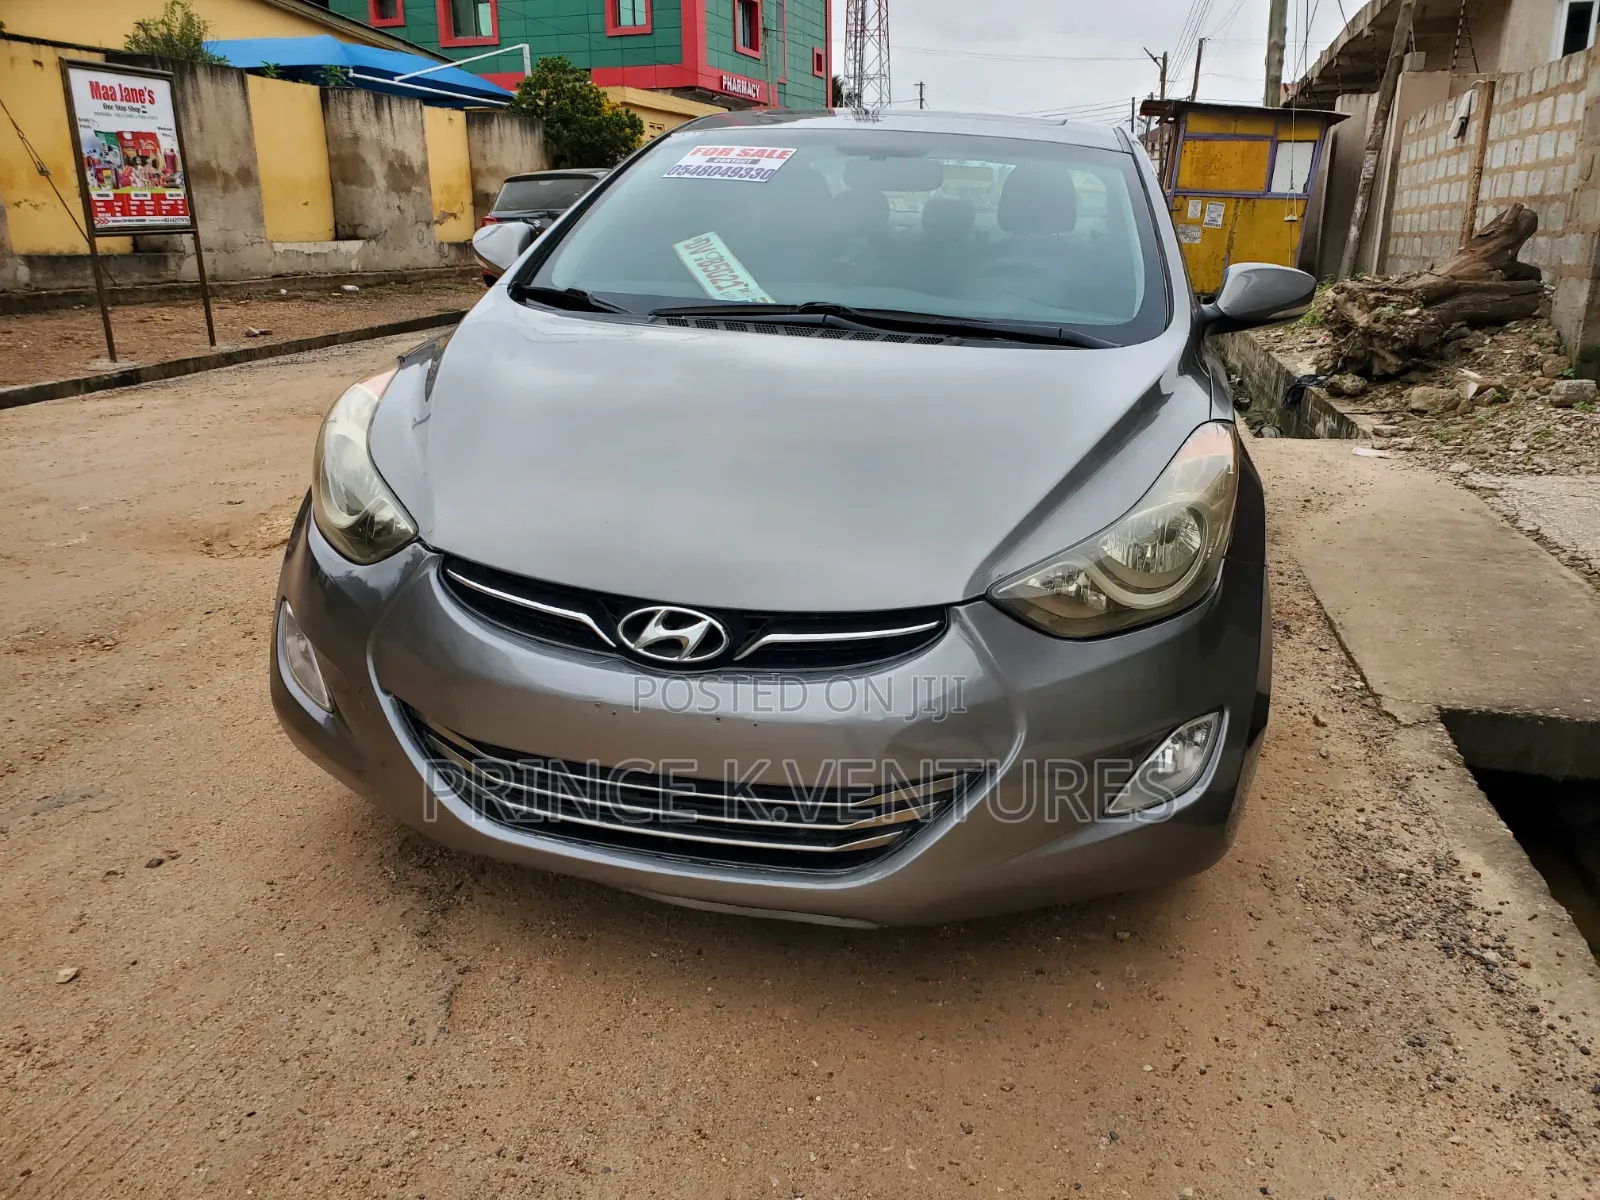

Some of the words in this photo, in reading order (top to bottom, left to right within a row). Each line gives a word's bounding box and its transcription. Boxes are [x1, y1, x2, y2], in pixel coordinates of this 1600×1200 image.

[89, 80, 118, 102] Maa
[118, 84, 156, 106] Jane's
[722, 75, 760, 99] PHARMACY
[103, 102, 114, 111] One
[115, 103, 127, 113] Stop
[128, 104, 142, 114] Shop
[689, 147, 735, 157] FOR
[736, 147, 793, 160] SALE
[666, 164, 776, 180] 0548049330
